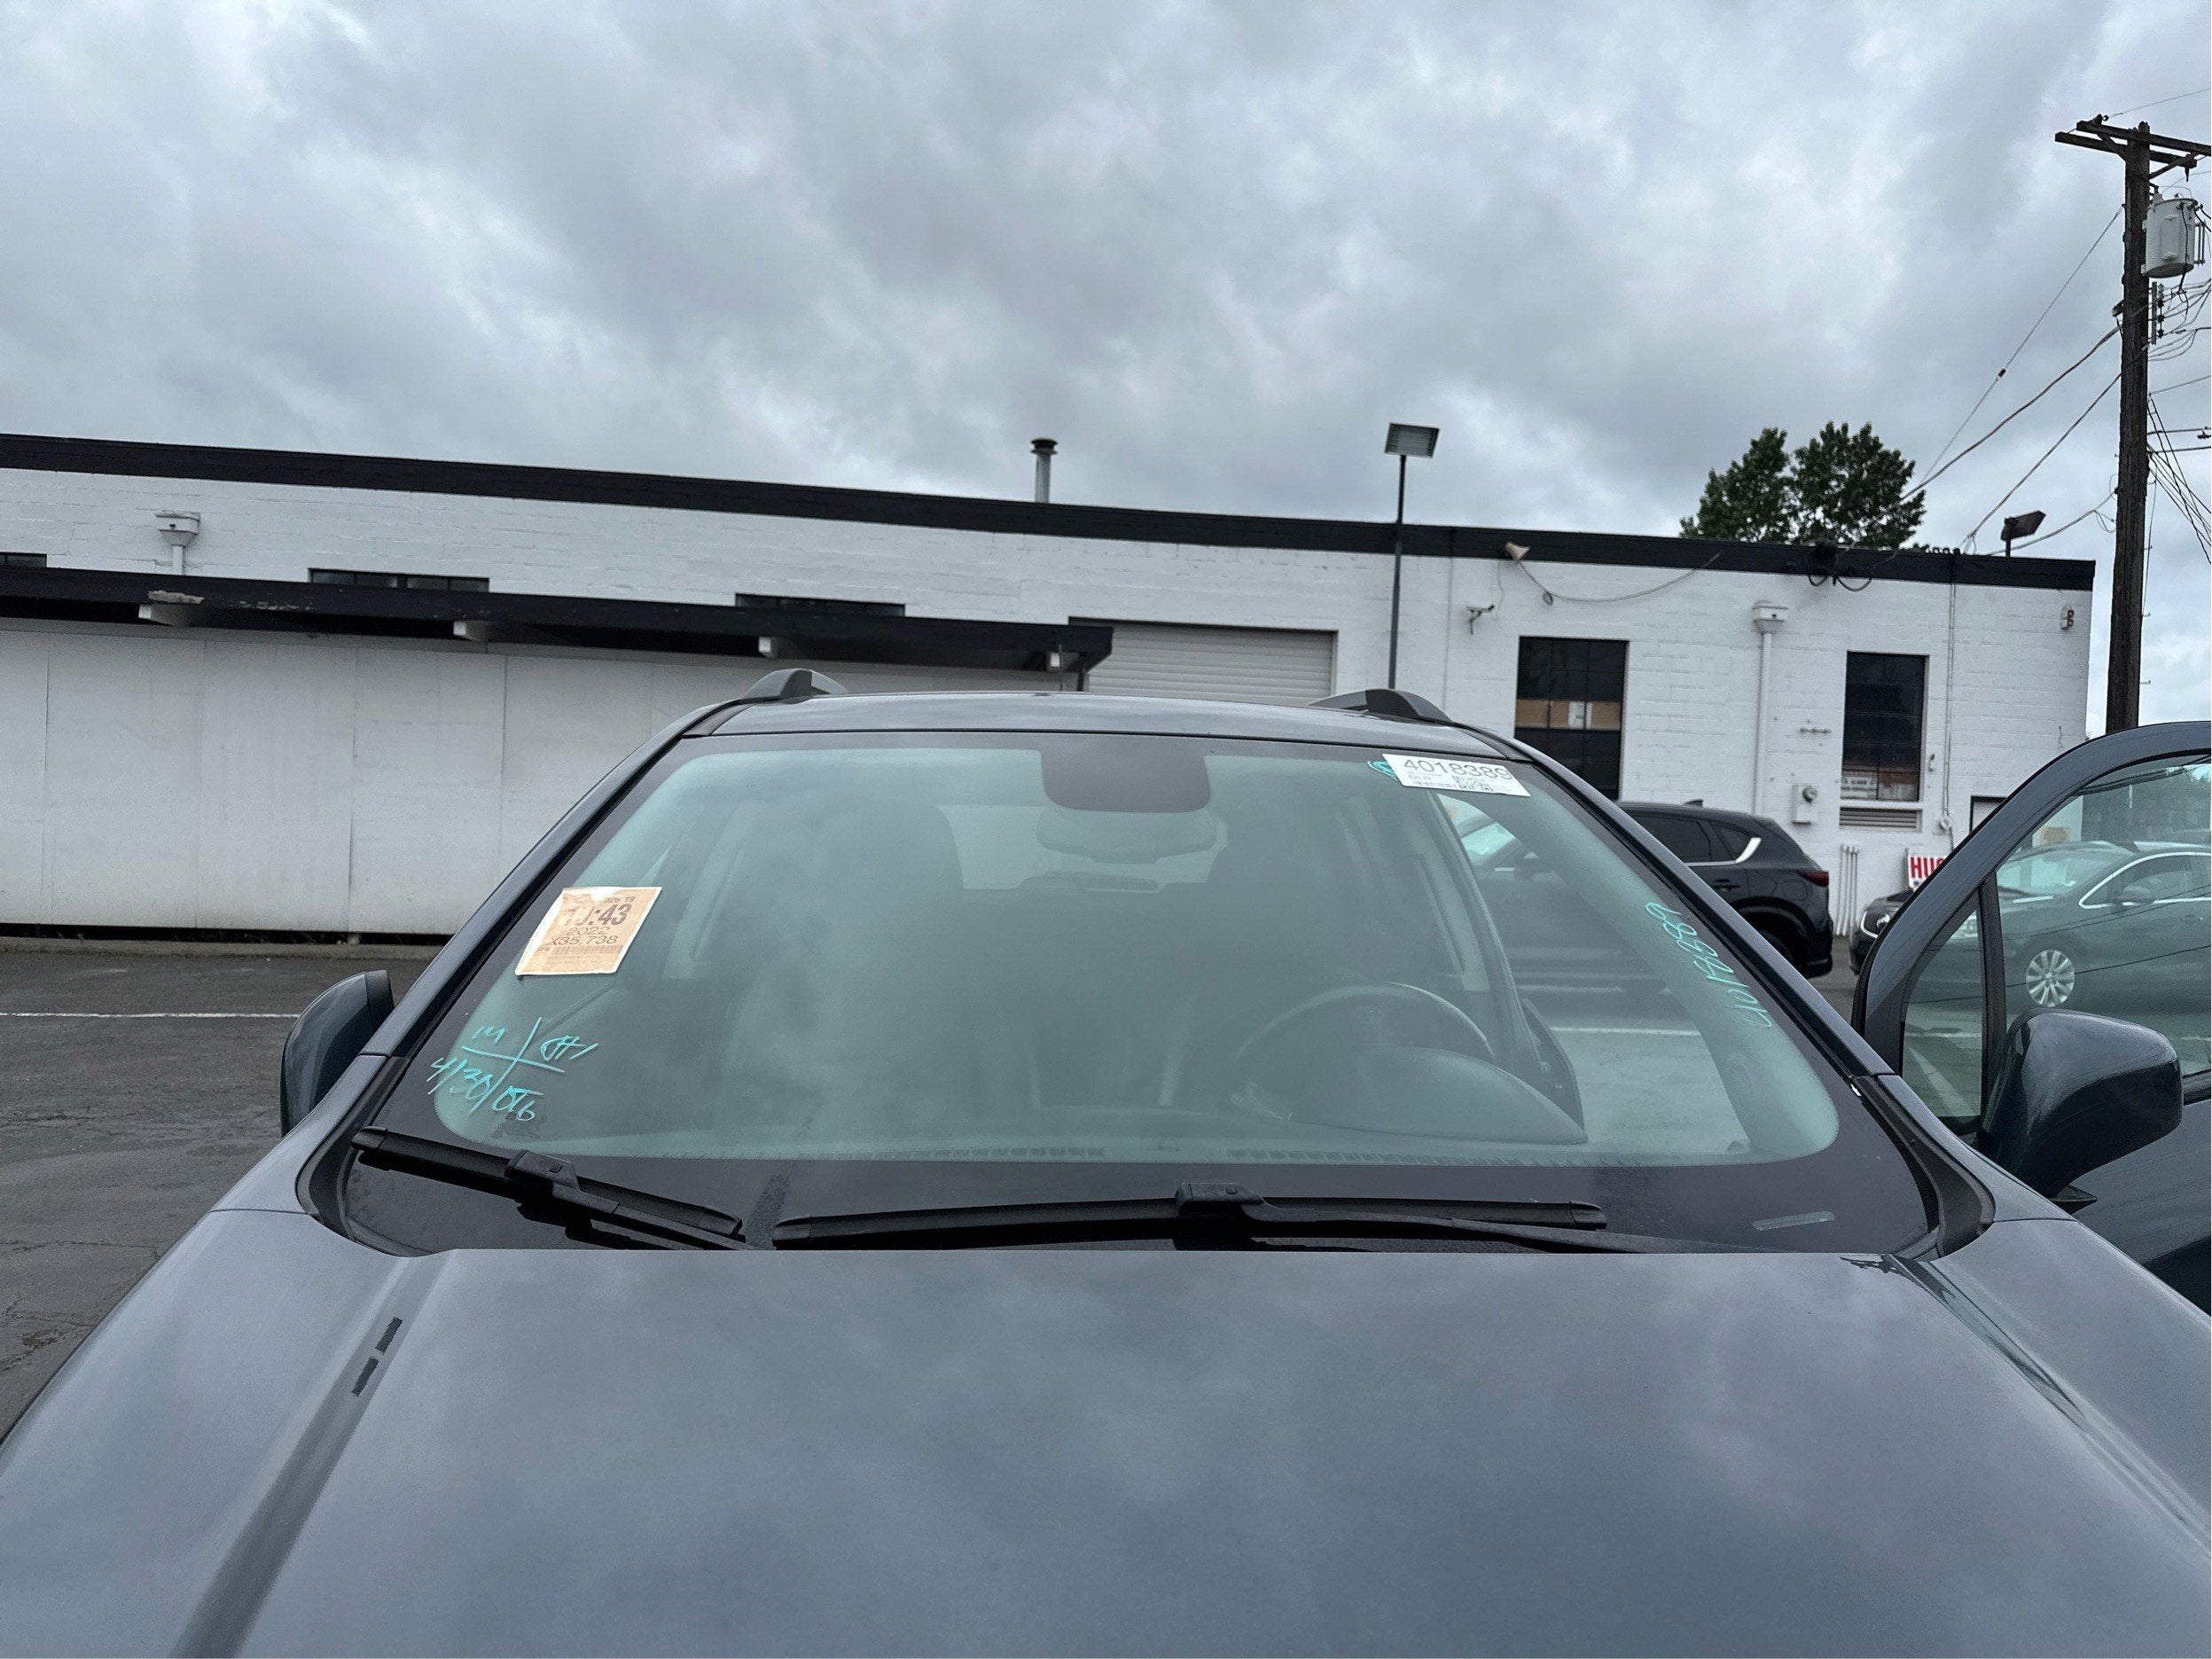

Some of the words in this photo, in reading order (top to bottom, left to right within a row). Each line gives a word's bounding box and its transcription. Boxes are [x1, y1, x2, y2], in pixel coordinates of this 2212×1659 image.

[1403, 759, 1512, 780] 4018389
[1910, 857, 1946, 879] HU
[566, 927, 611, 936] 2022
